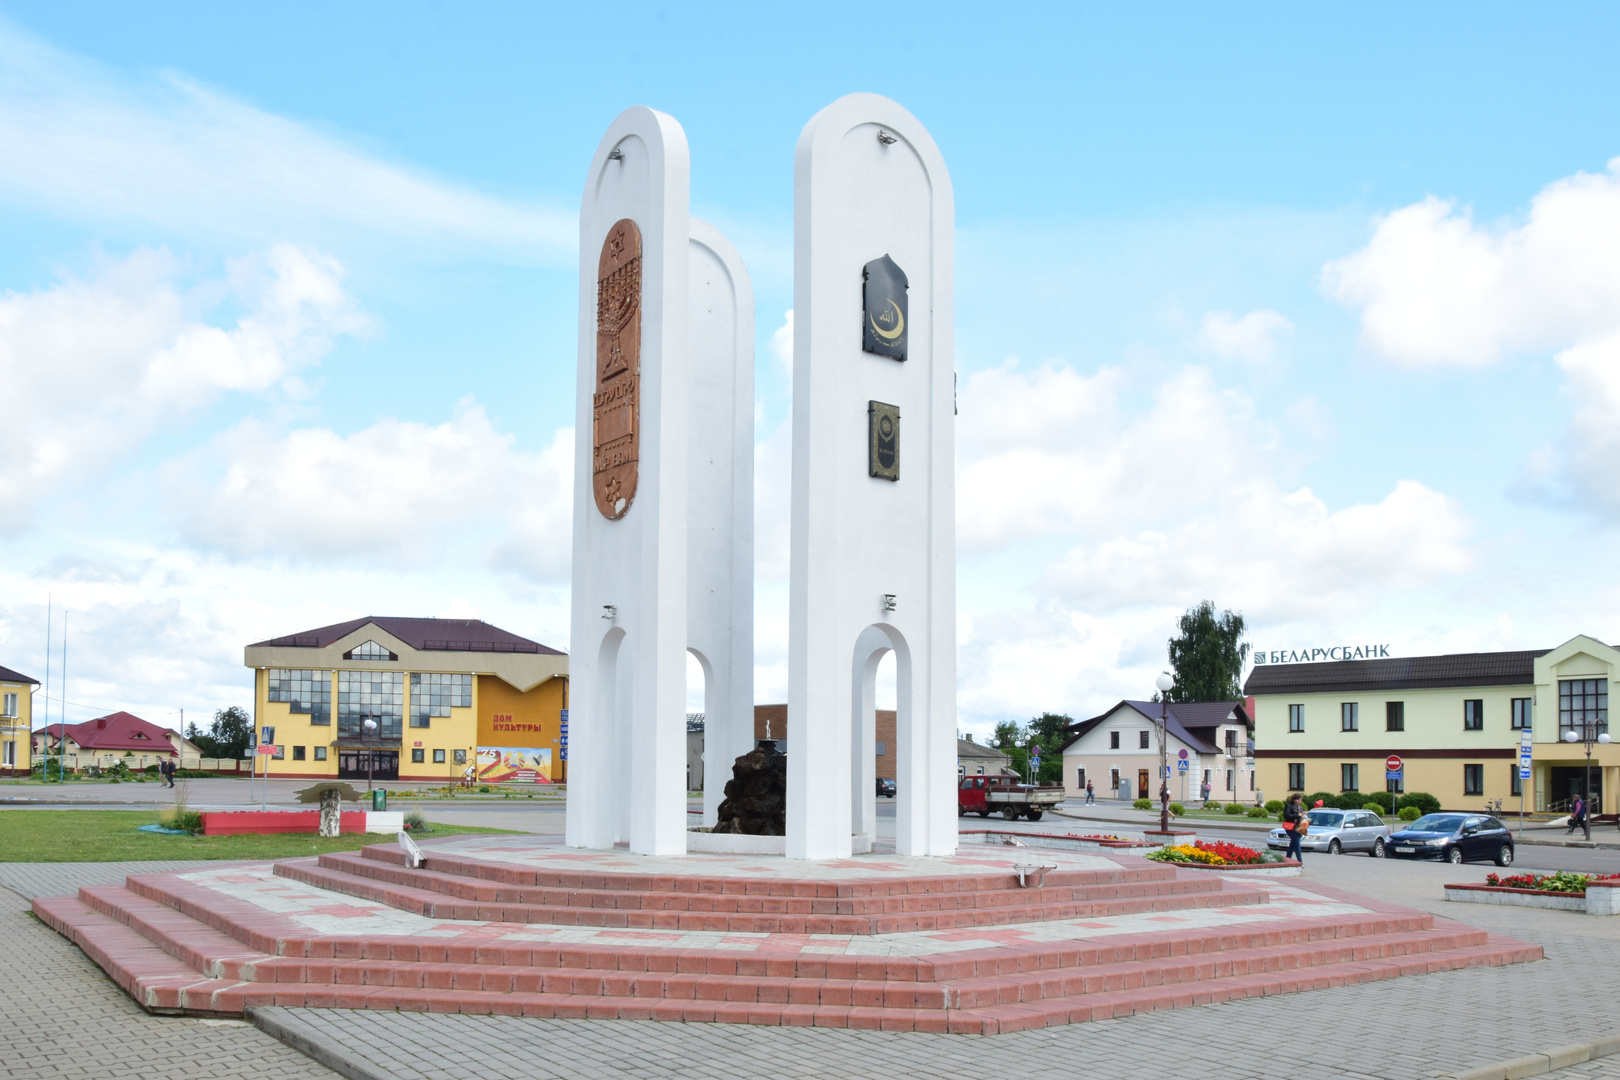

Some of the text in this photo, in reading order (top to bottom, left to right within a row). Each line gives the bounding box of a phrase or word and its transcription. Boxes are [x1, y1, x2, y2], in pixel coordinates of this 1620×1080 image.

[1270, 644, 1391, 664] БЕЛАРУСБАНК
[493, 714, 512, 722] ДОМ
[493, 723, 542, 732] КУЛЬТУРЫ
[481, 750, 496, 758] 75
